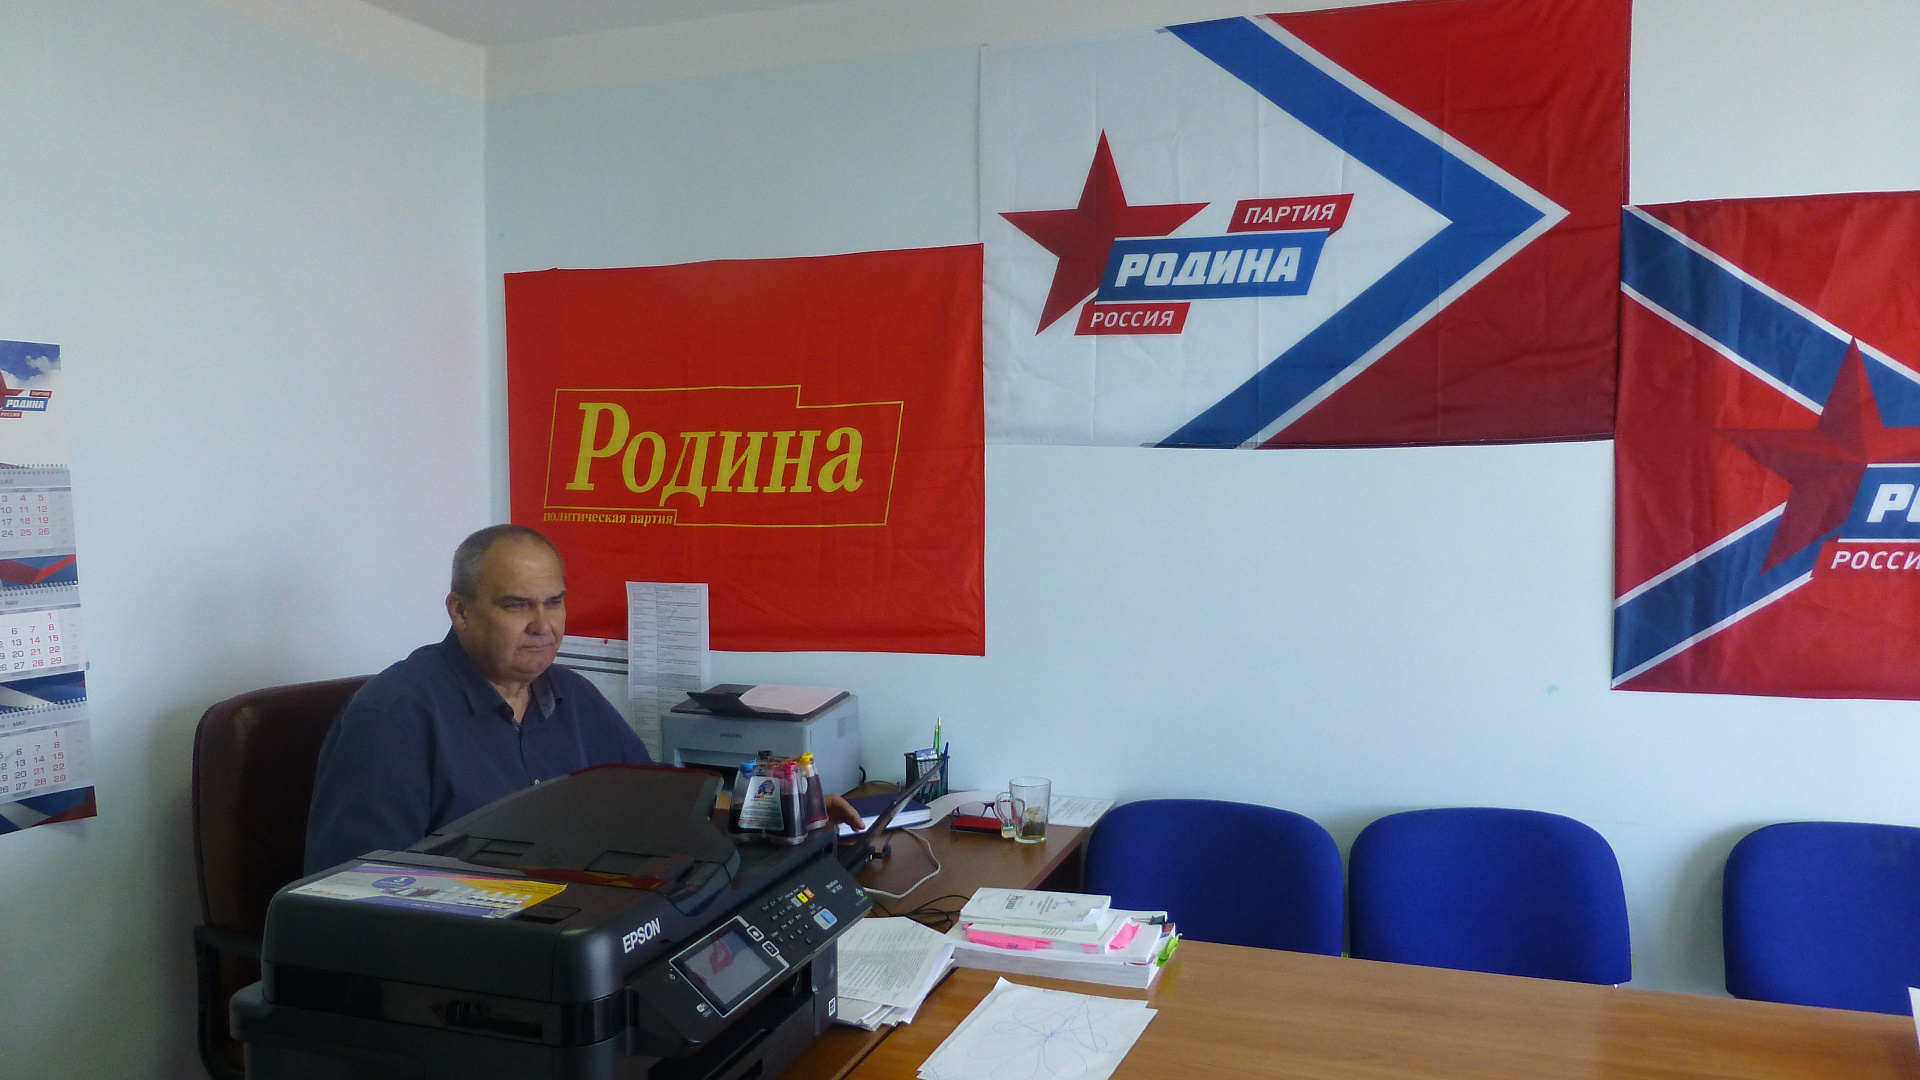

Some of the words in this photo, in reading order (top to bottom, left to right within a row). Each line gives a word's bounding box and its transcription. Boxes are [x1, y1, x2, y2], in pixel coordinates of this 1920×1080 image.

[1243, 202, 1337, 225] ПАРТИЯ
[1114, 246, 1302, 288] РОДИНА
[1090, 310, 1175, 328] РОССИЯ
[5, 399, 45, 408] РОДИНА
[565, 402, 864, 508] Родина
[2, 518, 12, 526] 17
[543, 510, 626, 524] политическая
[630, 513, 674, 527] партия
[12, 650, 24, 658] 20
[30, 648, 41, 656] 21
[49, 646, 60, 654] 22
[14, 662, 24, 670] 27
[51, 657, 62, 665] 29
[15, 759, 26, 767] 13
[53, 752, 64, 760] 15
[15, 771, 27, 779] 20
[34, 767, 45, 775] 21
[53, 764, 65, 772] 22
[16, 782, 27, 790] 27
[54, 775, 66, 783] 29
[622, 917, 662, 954] EPSON
